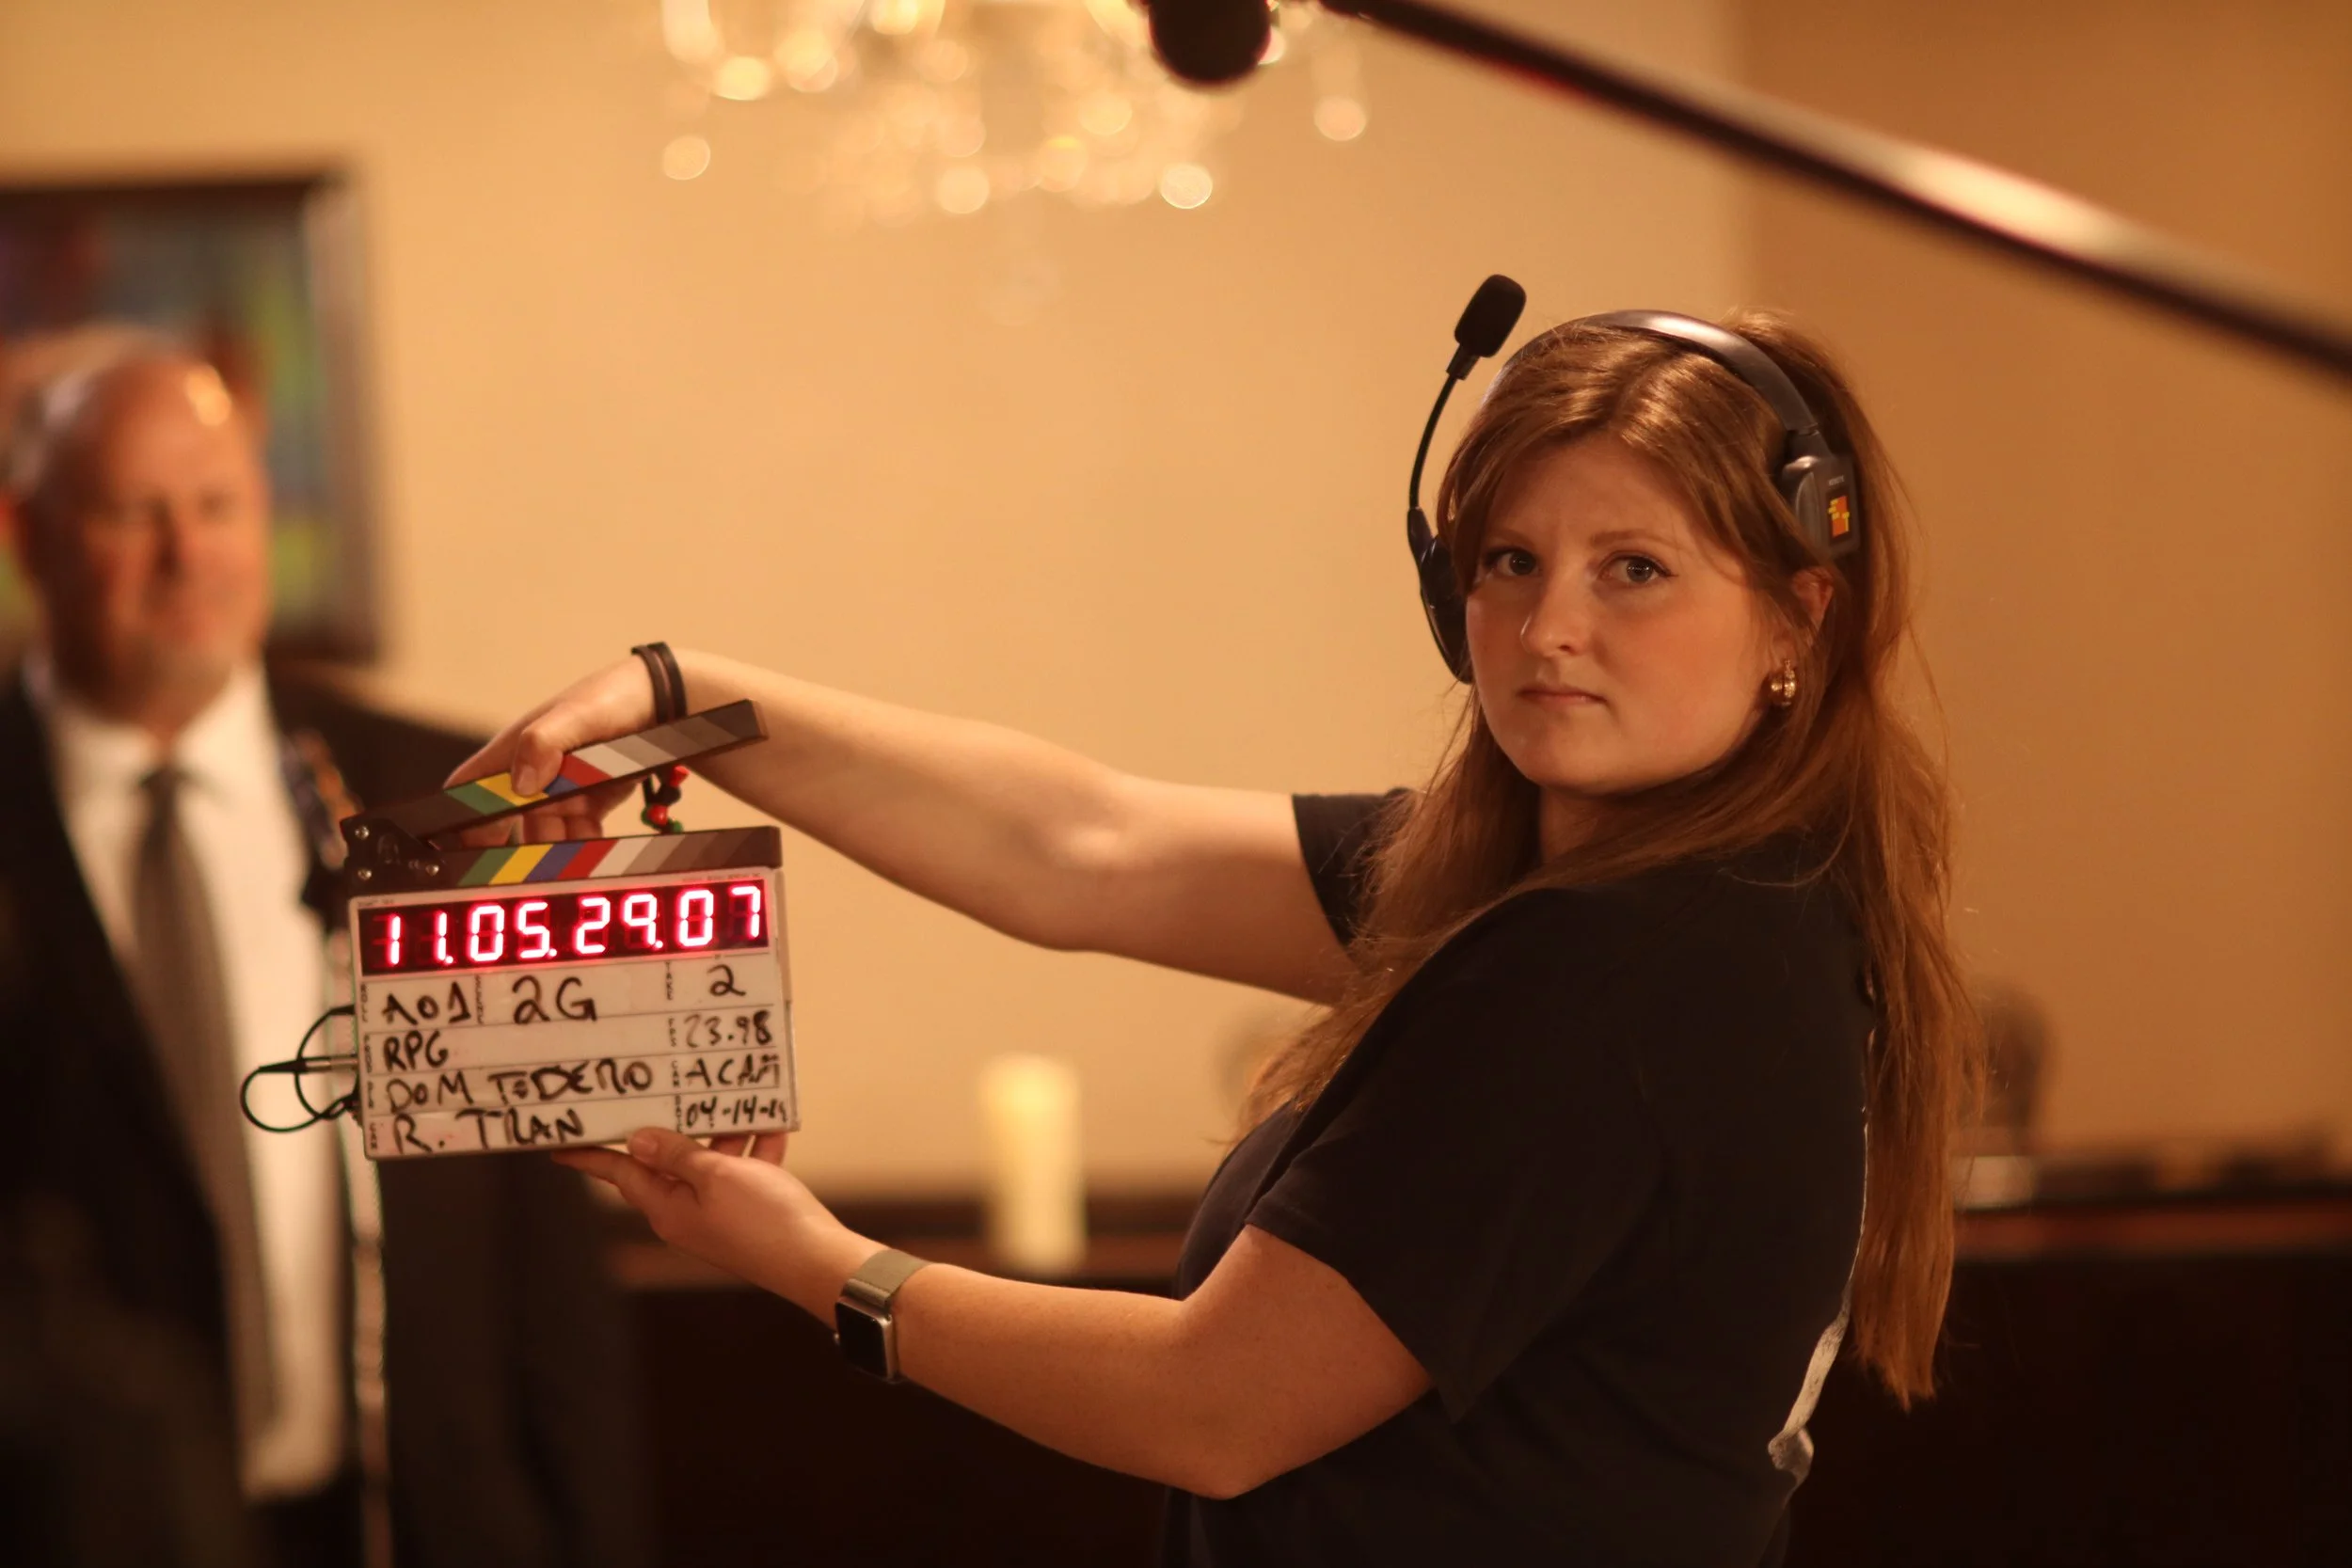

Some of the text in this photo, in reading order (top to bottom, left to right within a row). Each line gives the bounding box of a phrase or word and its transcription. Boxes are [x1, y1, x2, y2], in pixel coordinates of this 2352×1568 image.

[512, 974, 596, 1025] 2G
[665, 961, 674, 1000] TAKE
[707, 963, 747, 997] 2
[667, 1017, 677, 1047] FPS
[684, 1008, 773, 1049] 23.98
[383, 1029, 449, 1071] RPG
[671, 1060, 681, 1087] CAM
[393, 1112, 446, 1155] R.
